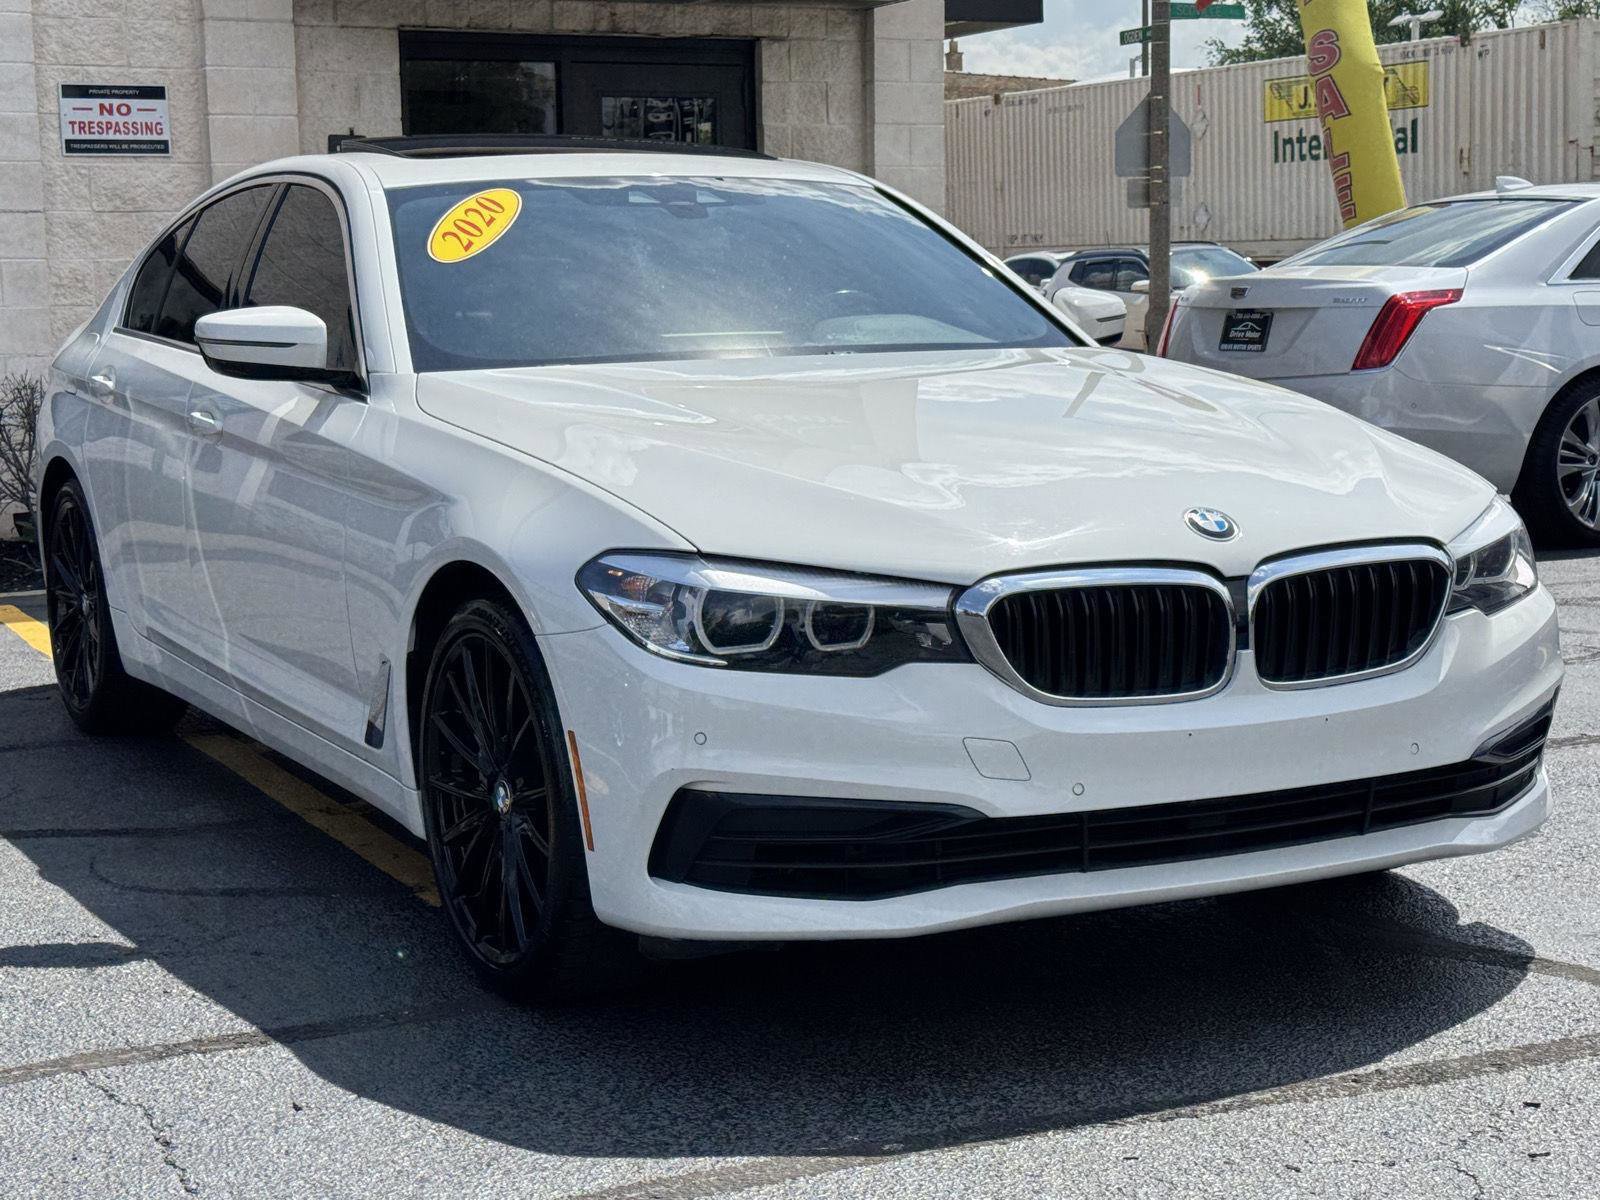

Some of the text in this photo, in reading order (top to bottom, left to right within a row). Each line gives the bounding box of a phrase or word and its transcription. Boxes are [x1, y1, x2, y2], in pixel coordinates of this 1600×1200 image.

[1124, 30, 1142, 44] OGDEN
[99, 103, 132, 116] NO
[69, 121, 164, 136] TRESPASSING
[442, 197, 505, 252] 2020
